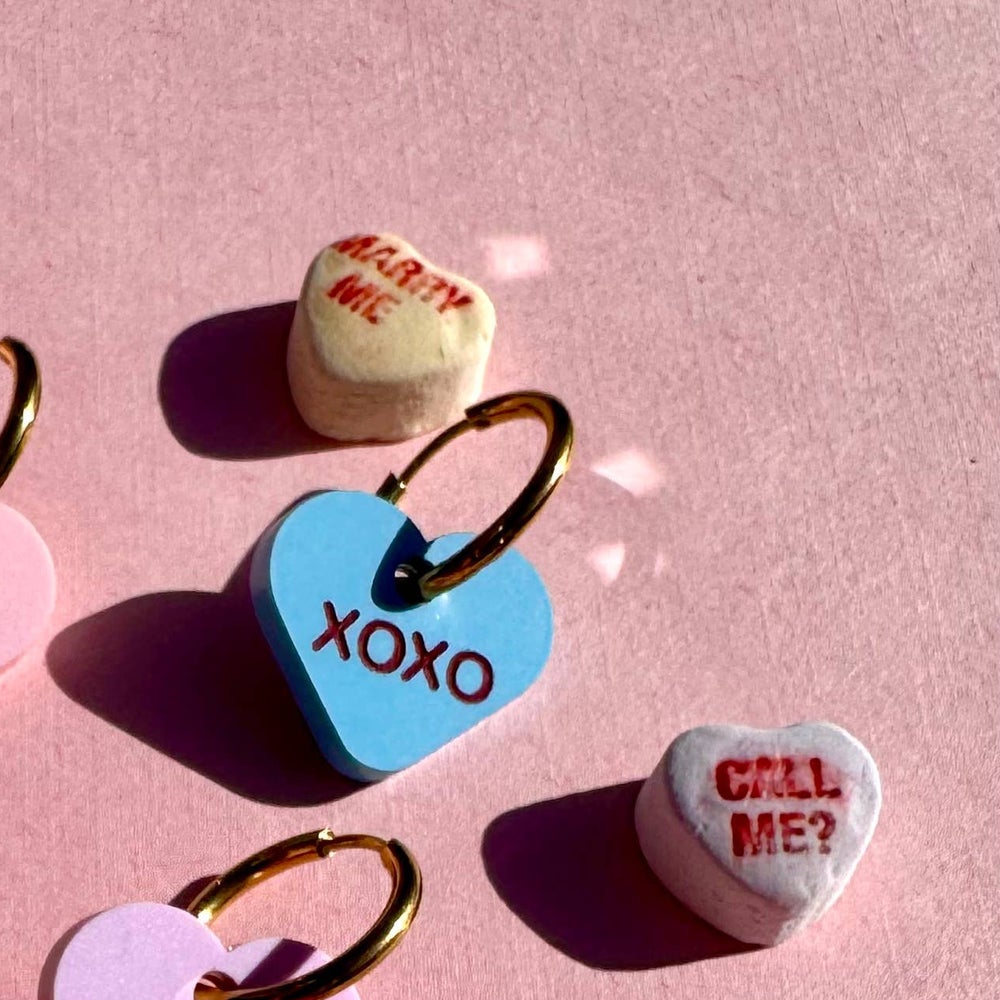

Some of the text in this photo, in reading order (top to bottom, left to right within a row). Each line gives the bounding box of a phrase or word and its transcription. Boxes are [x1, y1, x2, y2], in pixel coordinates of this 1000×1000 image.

[311, 600, 494, 704] XOXO
[715, 757, 842, 801] CALL
[730, 810, 837, 857] ME?
